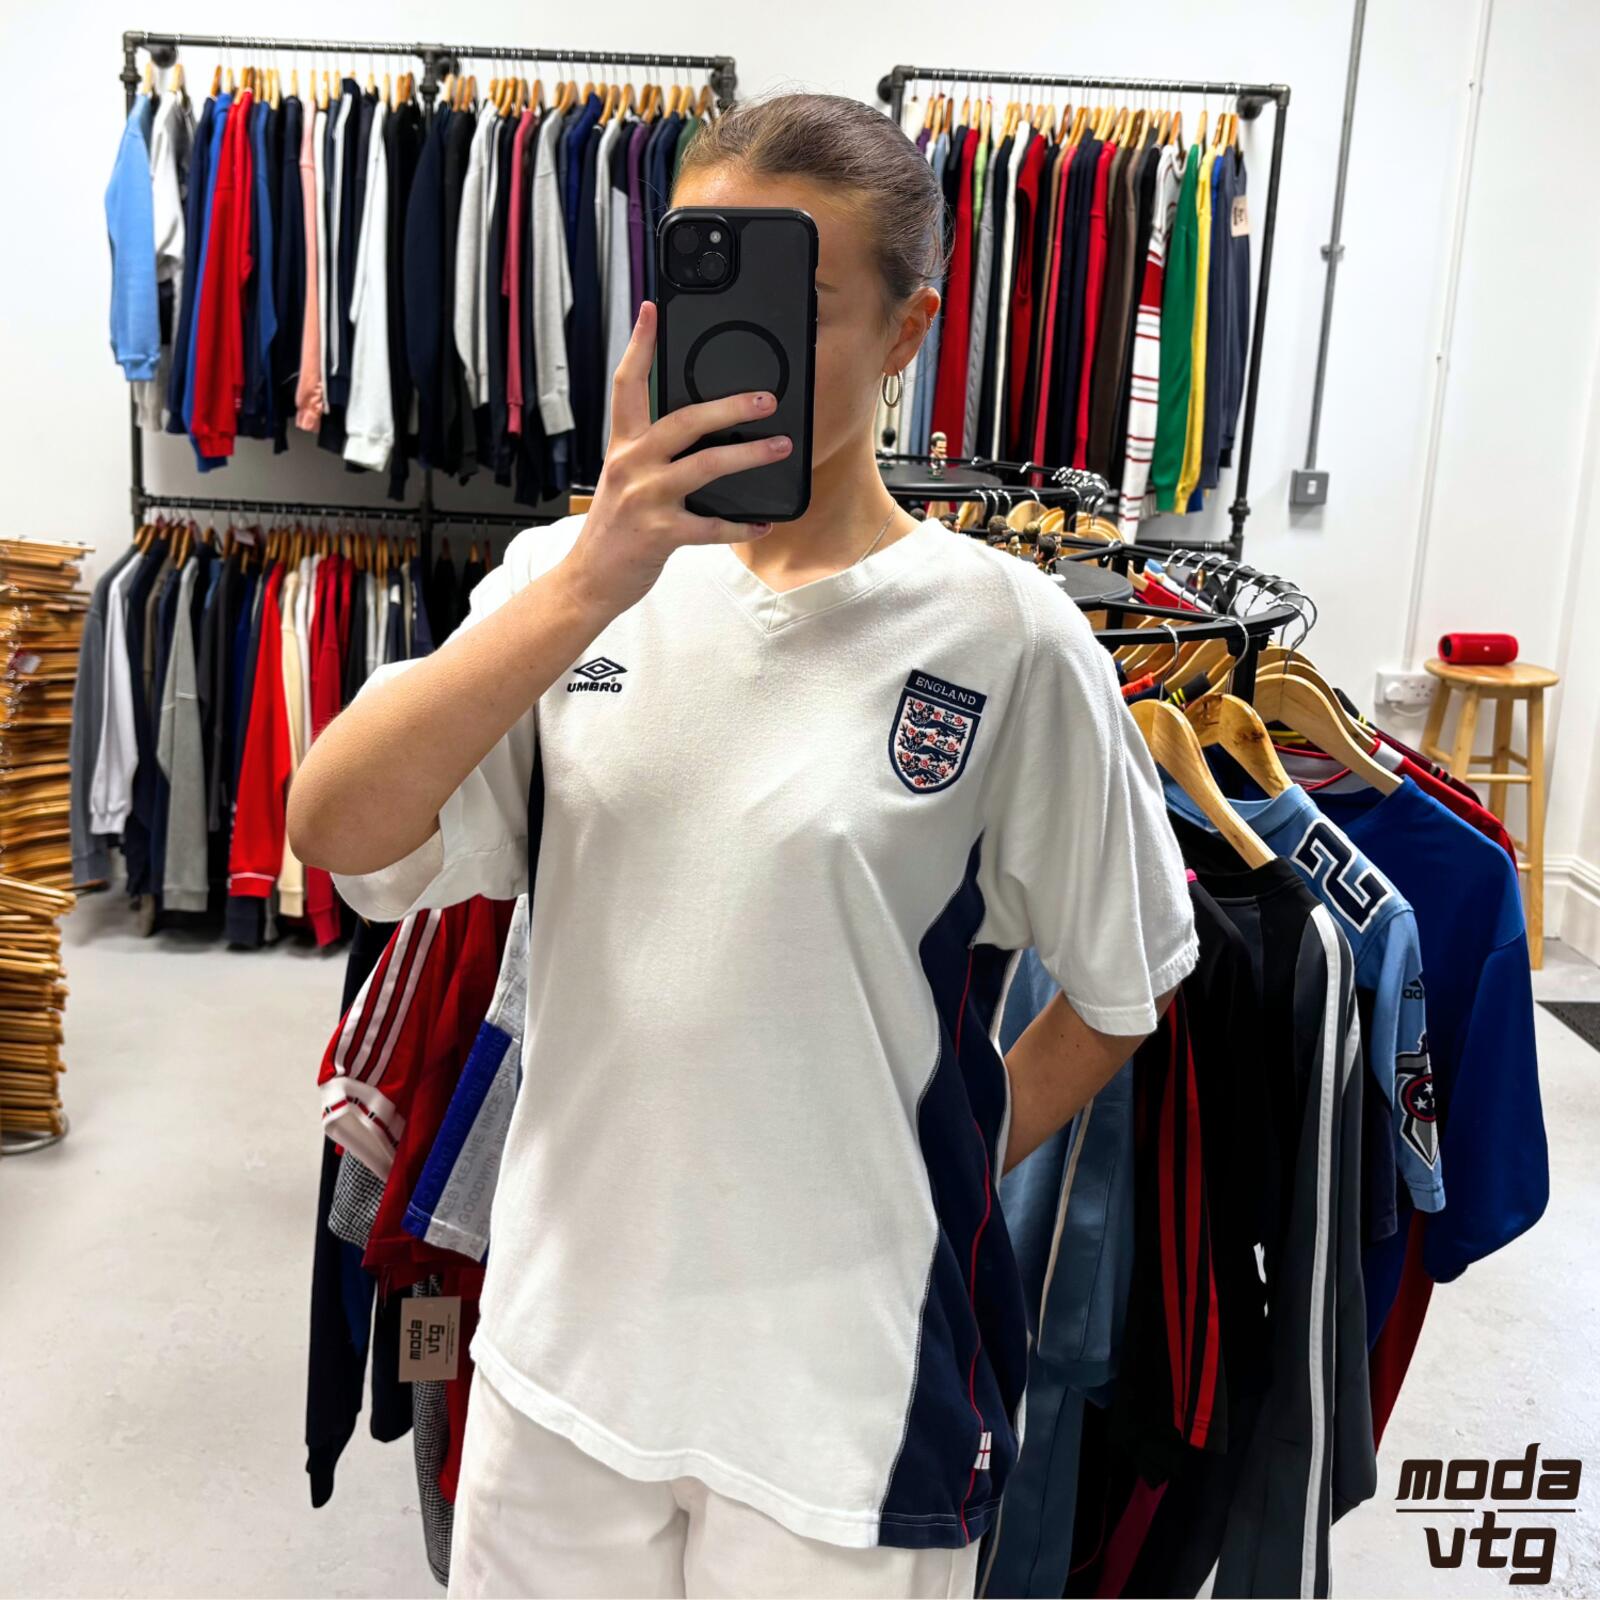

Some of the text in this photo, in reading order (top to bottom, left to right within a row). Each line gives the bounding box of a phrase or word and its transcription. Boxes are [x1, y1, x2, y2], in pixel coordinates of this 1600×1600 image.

[567, 681, 623, 693] UMBRO
[915, 676, 977, 705] ENGLAND
[1292, 819, 1393, 933] 2
[454, 1132, 485, 1184] KEANE
[478, 1092, 504, 1130] INCE
[457, 1151, 498, 1225] GOODWIN
[406, 1320, 422, 1360] moda
[425, 1325, 445, 1354] vtg
